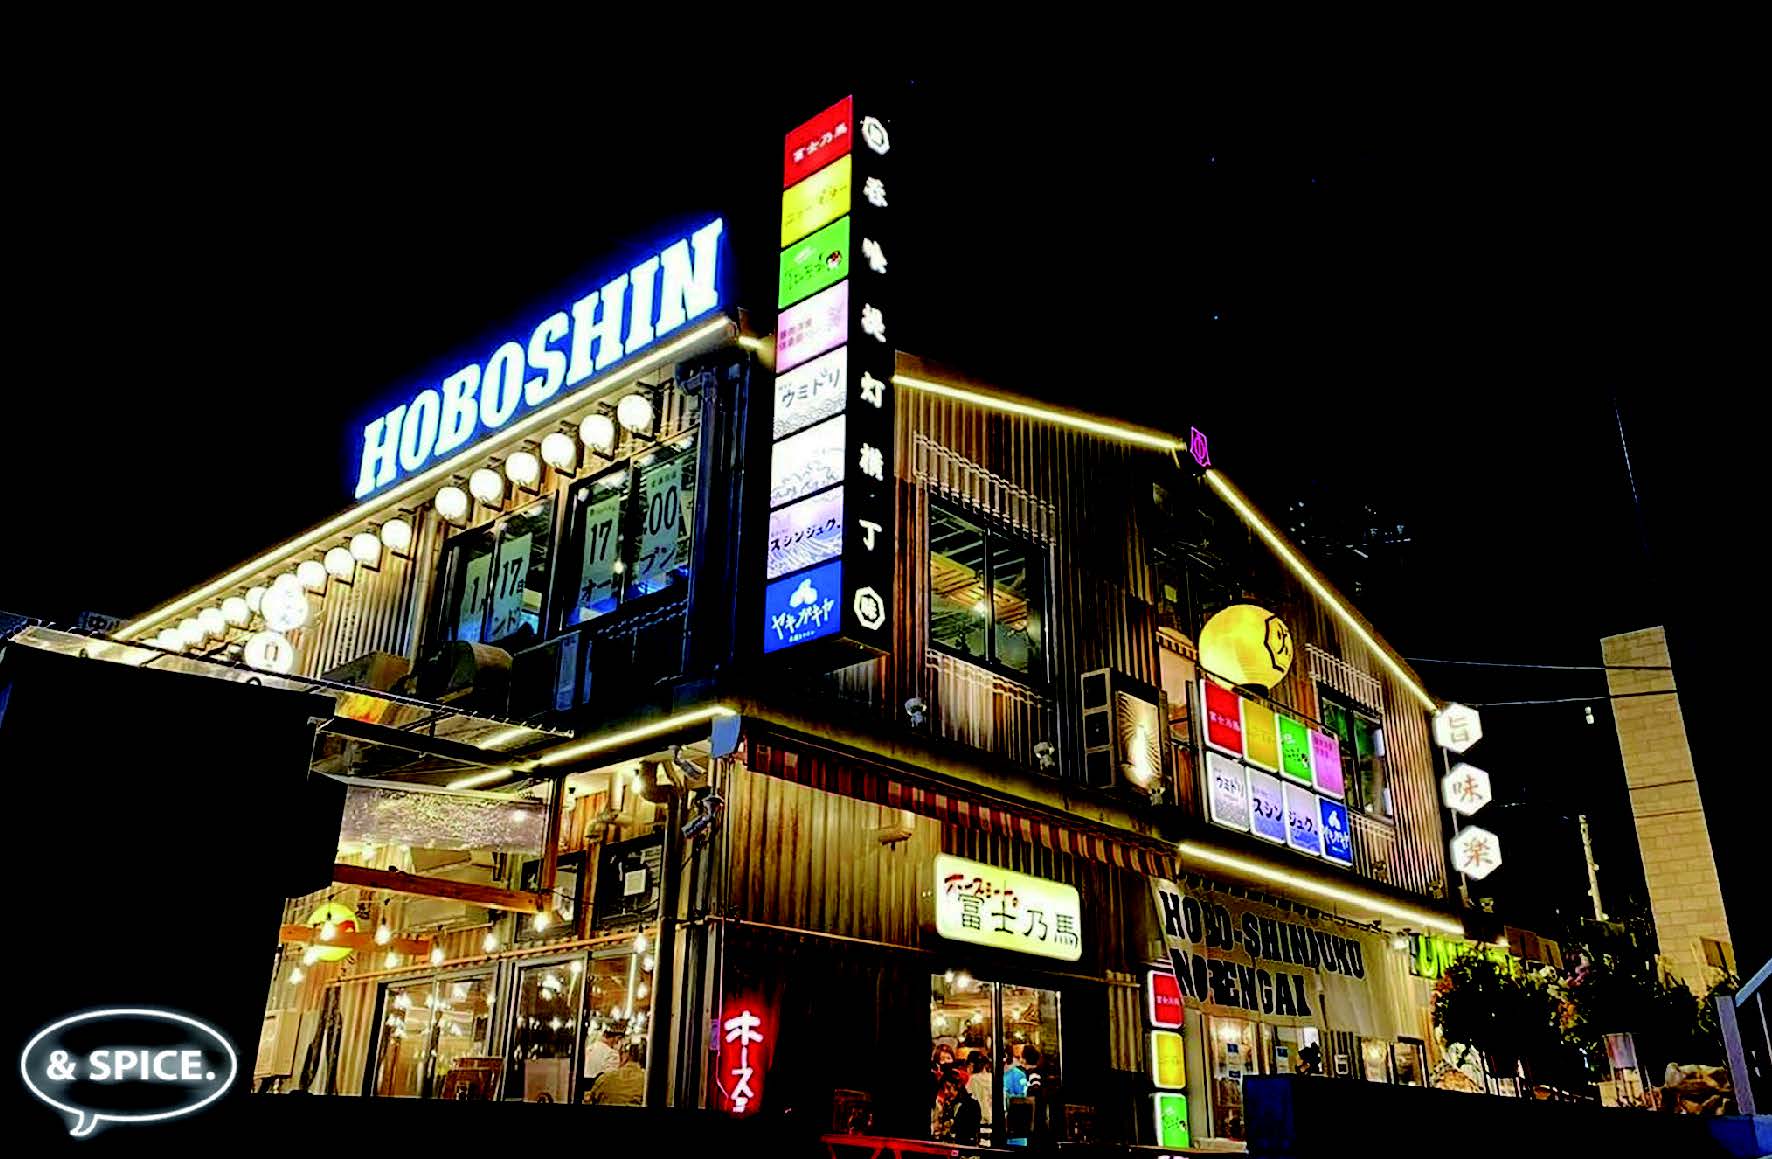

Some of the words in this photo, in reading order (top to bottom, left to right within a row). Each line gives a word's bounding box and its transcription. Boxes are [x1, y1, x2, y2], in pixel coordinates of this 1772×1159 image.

[354, 216, 724, 500] HOBOSHIN
[781, 367, 841, 408] ウミドリ
[1452, 774, 1483, 802] 味
